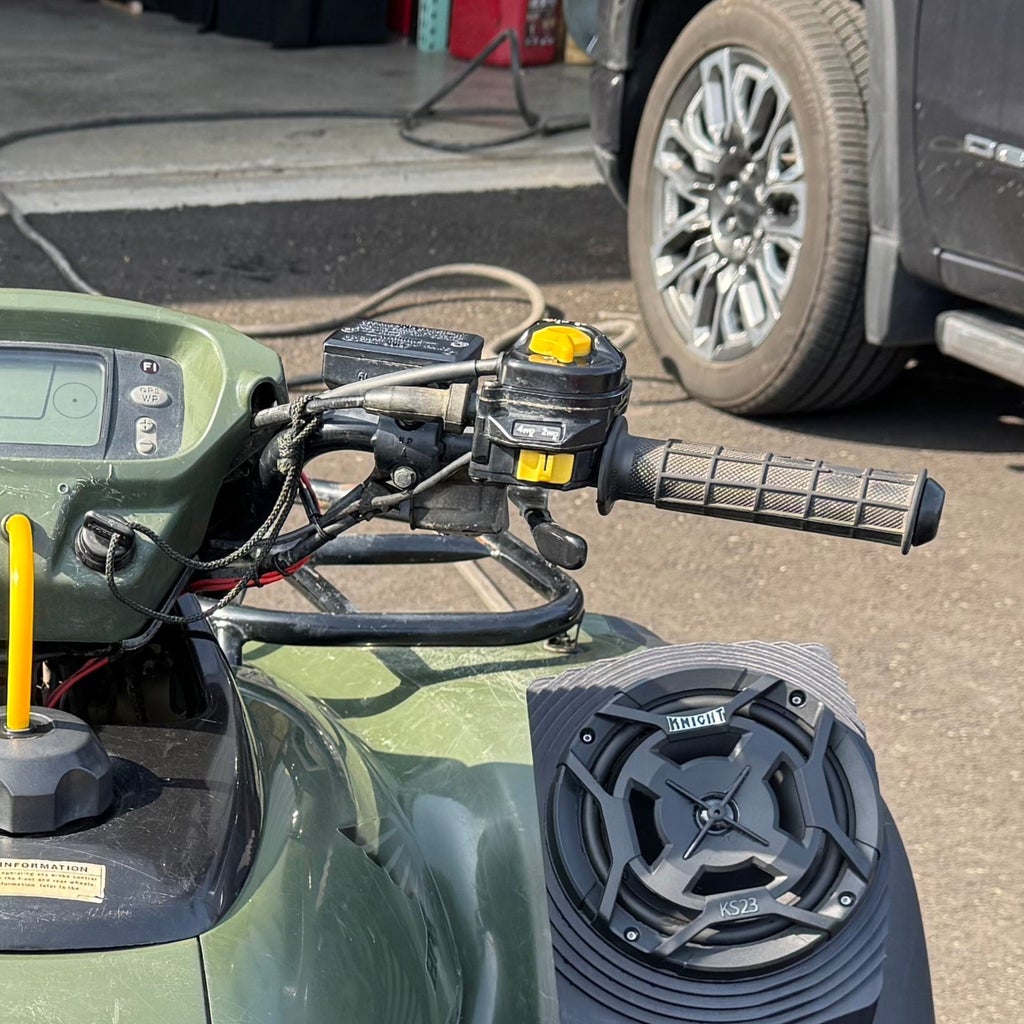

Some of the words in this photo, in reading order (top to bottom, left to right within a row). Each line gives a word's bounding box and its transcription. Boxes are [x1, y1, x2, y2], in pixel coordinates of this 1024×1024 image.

[142, 361, 157, 373] FI
[668, 707, 725, 731] KNIGHT
[0, 861, 88, 873] INFORMATION
[719, 897, 759, 917] KS23
